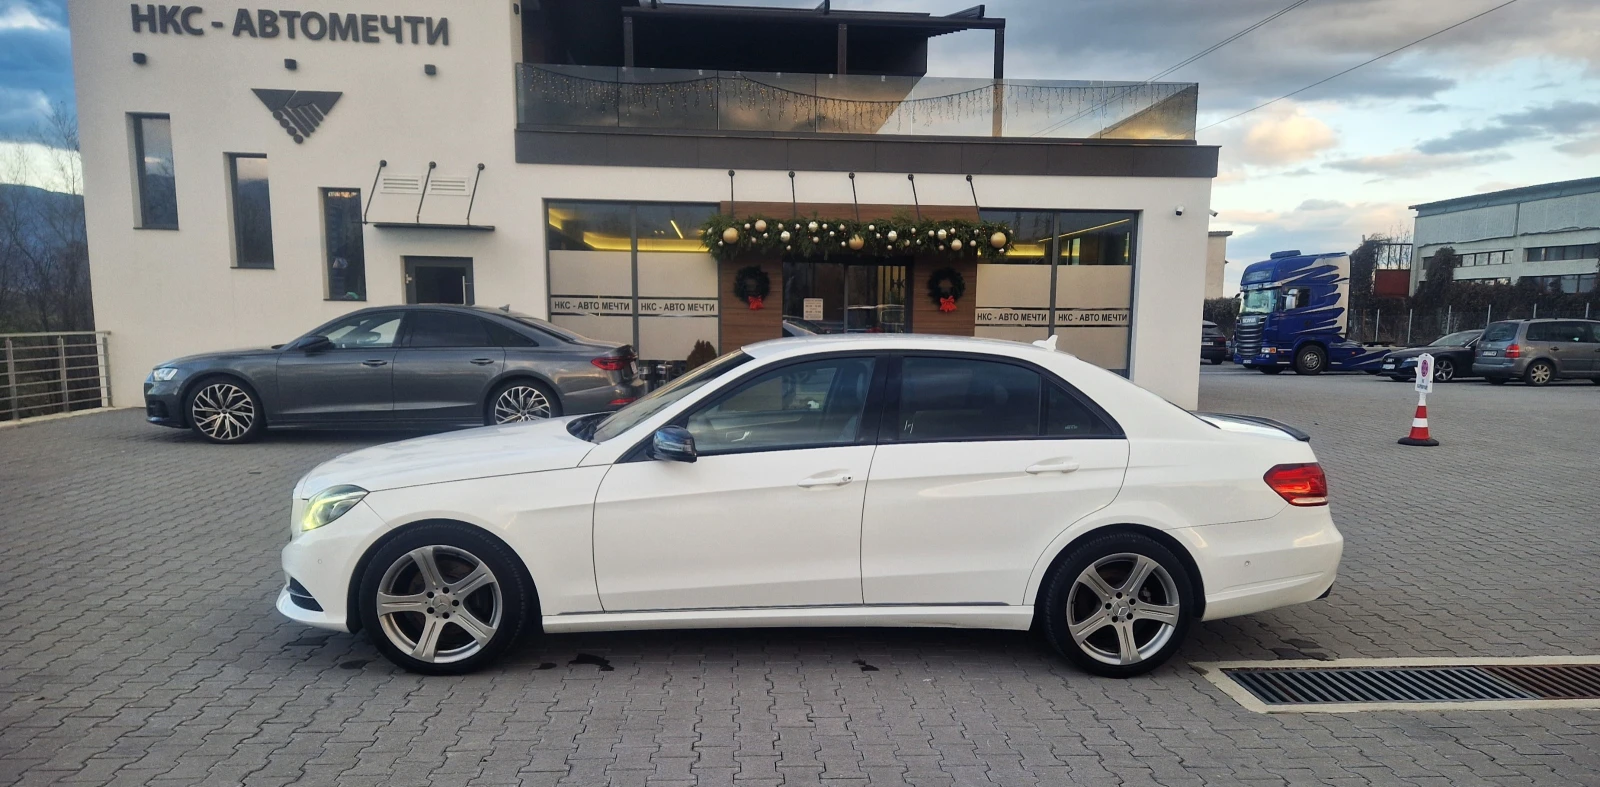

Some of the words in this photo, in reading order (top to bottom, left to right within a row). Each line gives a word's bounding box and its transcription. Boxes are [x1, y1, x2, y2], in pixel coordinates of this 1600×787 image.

[130, 4, 204, 36] НКС
[211, 20, 223, 28] -
[232, 8, 449, 46] АВТОМЕЧТИ
[554, 301, 570, 310] НКС
[578, 301, 600, 310] АВТО
[602, 302, 630, 311] МЕЧТИ
[640, 302, 657, 311] НКС
[664, 302, 686, 311] АВТО
[687, 303, 715, 312] МЕЧТИ
[977, 312, 992, 321] НКС
[998, 313, 1020, 321] АВТО
[1020, 313, 1047, 322] МЕЧТИ
[1058, 313, 1073, 322] НКС
[1080, 314, 1100, 322] АВТО
[1101, 314, 1128, 322] МЕЧТИ
